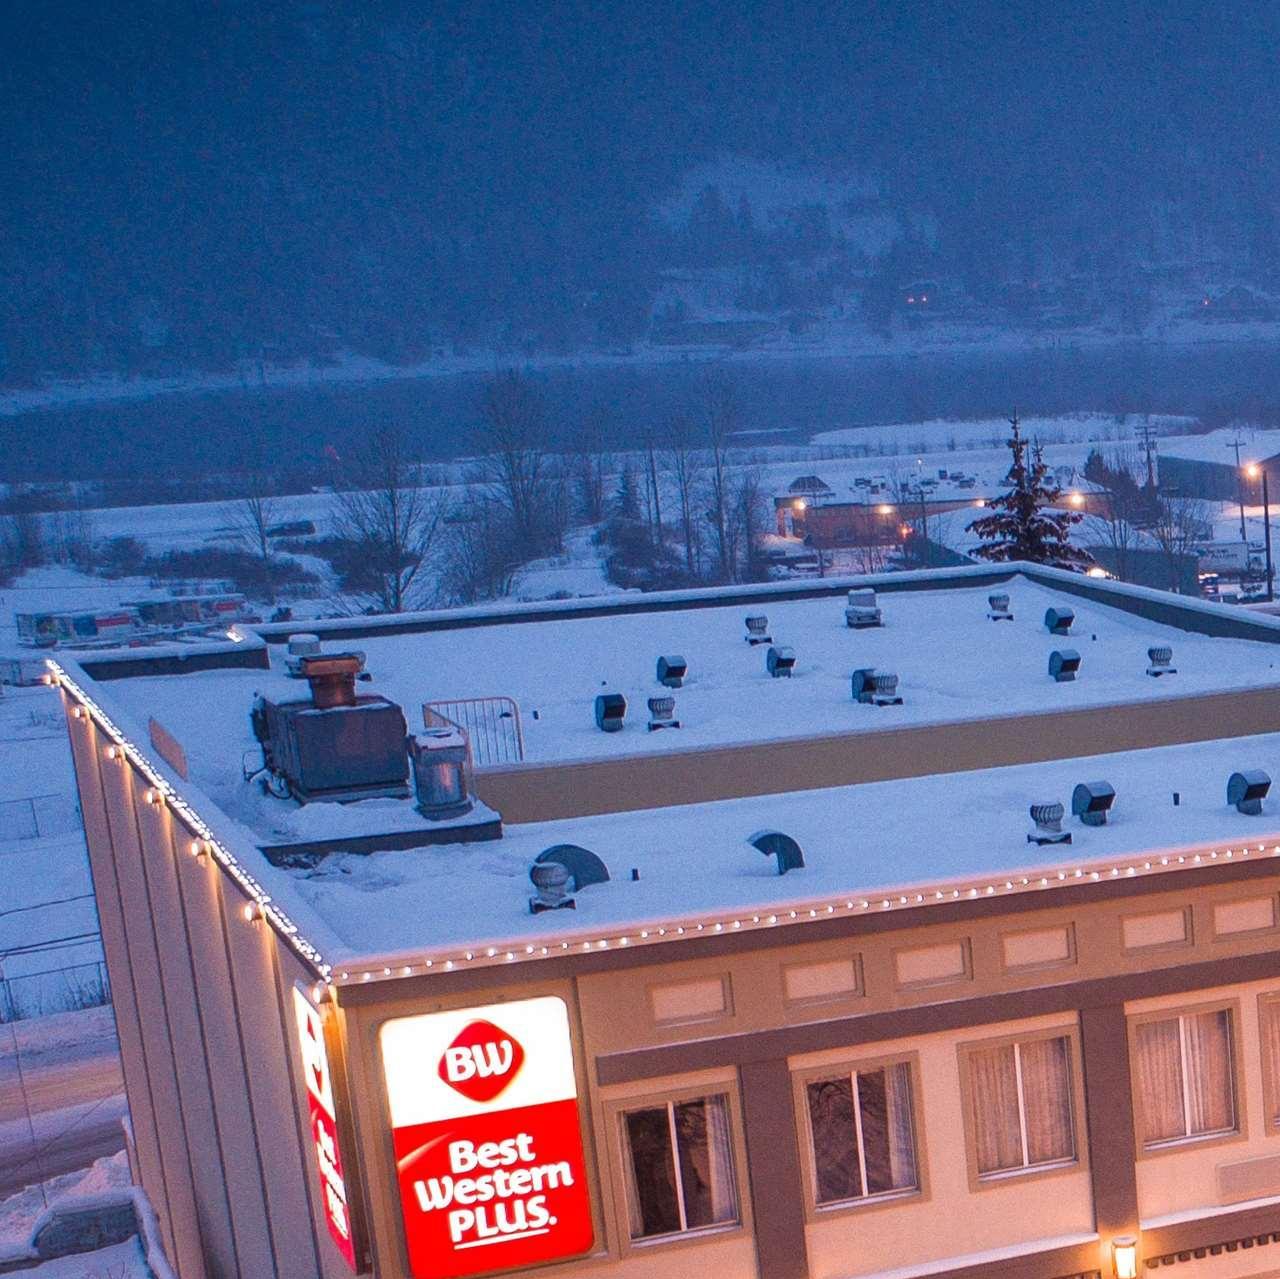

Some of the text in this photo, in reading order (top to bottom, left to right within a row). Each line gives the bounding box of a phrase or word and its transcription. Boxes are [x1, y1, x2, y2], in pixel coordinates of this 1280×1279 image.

[444, 1041, 512, 1082] BW
[449, 1133, 536, 1173] Best
[414, 1161, 574, 1212] Western
